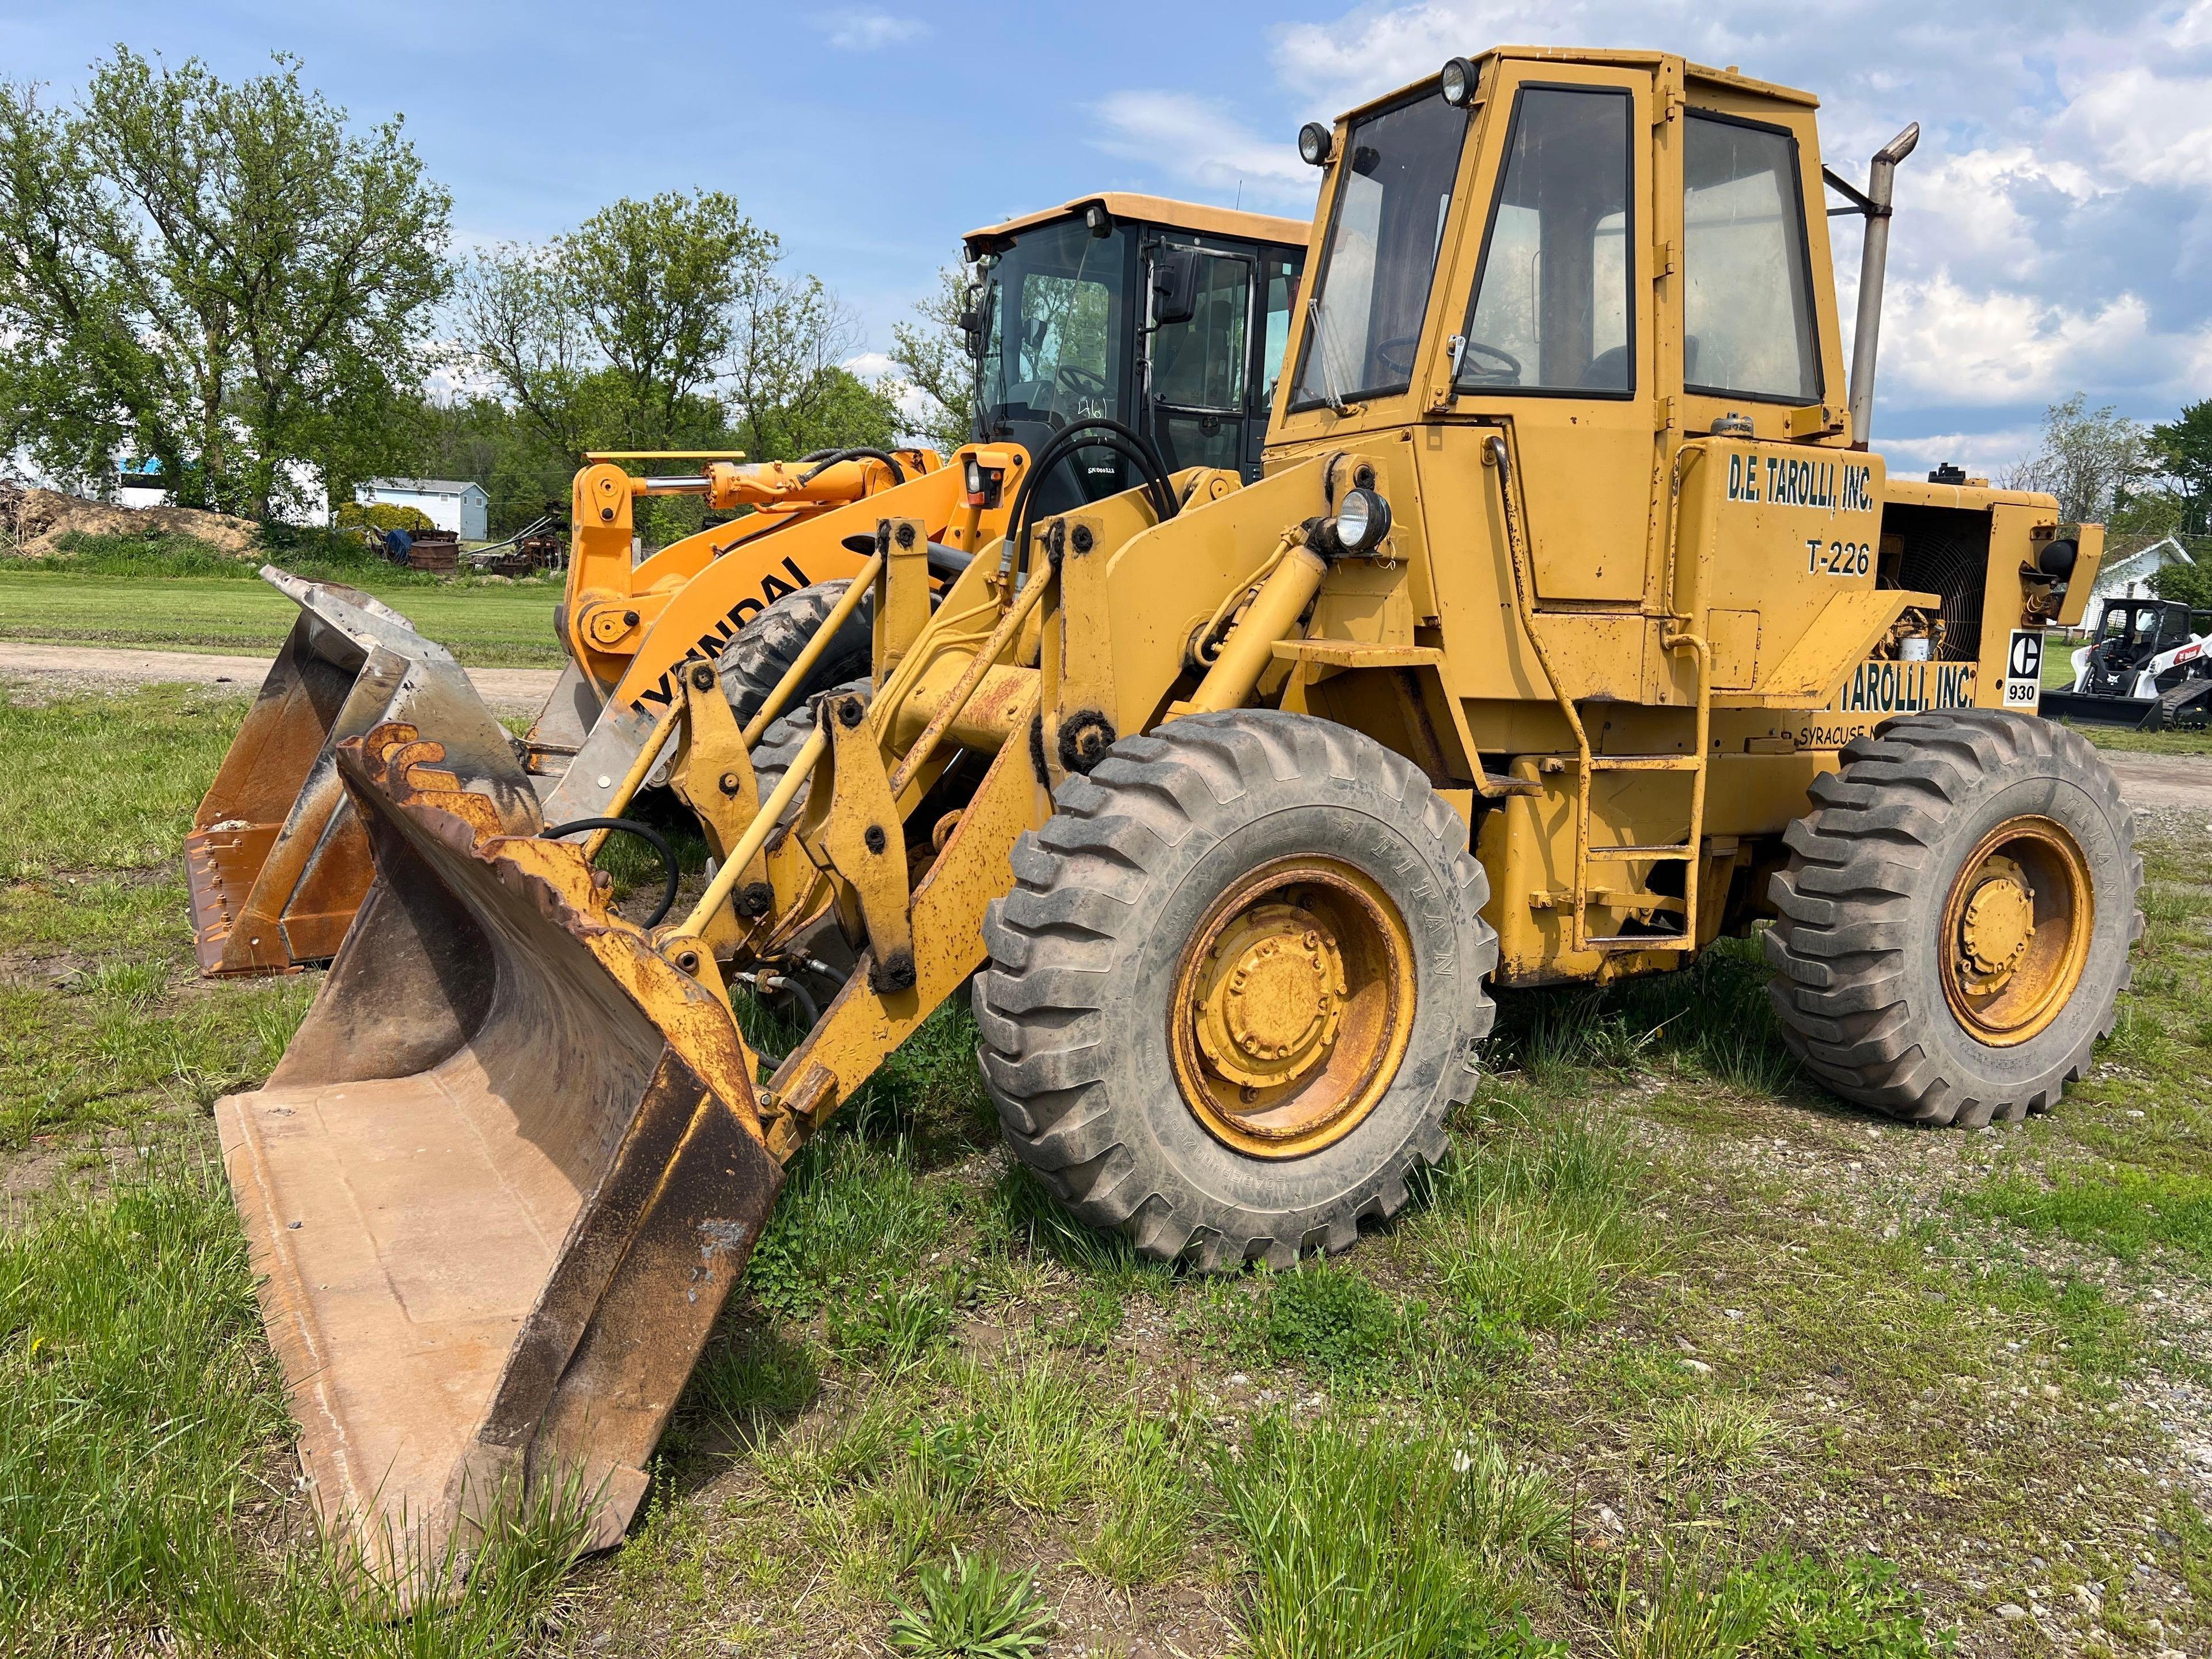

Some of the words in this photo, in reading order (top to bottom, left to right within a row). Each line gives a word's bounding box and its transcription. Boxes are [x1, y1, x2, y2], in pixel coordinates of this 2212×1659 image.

[1727, 454, 1760, 503] D.E.
[1766, 457, 1837, 521] TAROLLI,
[1840, 464, 1872, 512] INC.
[1805, 539, 1870, 577] T-226
[1935, 664, 1973, 709] INC.
[2009, 685, 2035, 700] 930
[1799, 725, 1865, 746] SYRACUSE
[1370, 834, 1455, 979] TITAN
